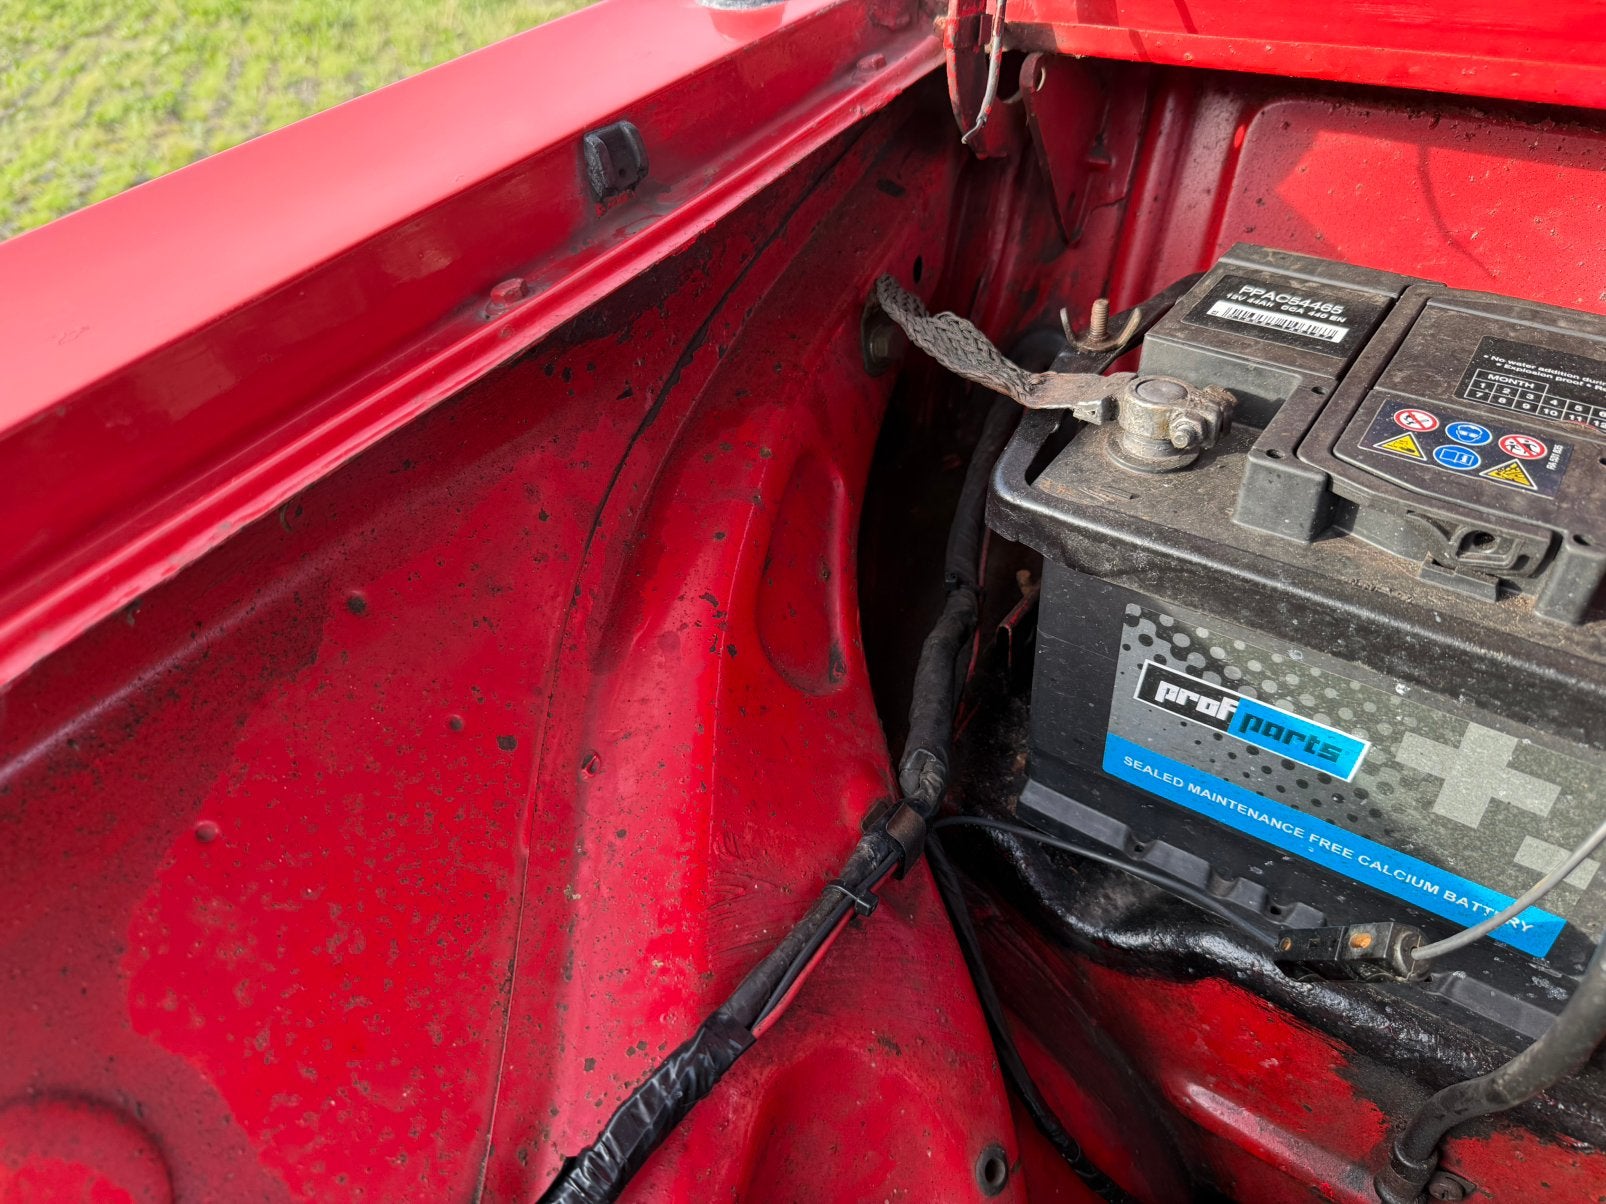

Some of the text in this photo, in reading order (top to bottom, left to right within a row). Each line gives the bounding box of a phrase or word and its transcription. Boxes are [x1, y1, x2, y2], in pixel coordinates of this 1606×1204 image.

[1239, 285, 1344, 314] PPAC54465
[1490, 355, 1505, 363] No
[1508, 359, 1536, 369] water
[1538, 366, 1580, 380] addition
[1503, 363, 1553, 379] Explosion
[1555, 376, 1585, 387] proof
[1487, 373, 1535, 389] MONTH
[1502, 387, 1511, 395] 2
[1574, 404, 1583, 412] 5
[1522, 402, 1531, 410] 9
[1543, 408, 1558, 416] 10
[1569, 414, 1583, 422] 11
[1155, 680, 1342, 763] prof parts
[1123, 756, 1534, 932] SEALED MAINTENANCE FREE CALCIUM BATTRY
